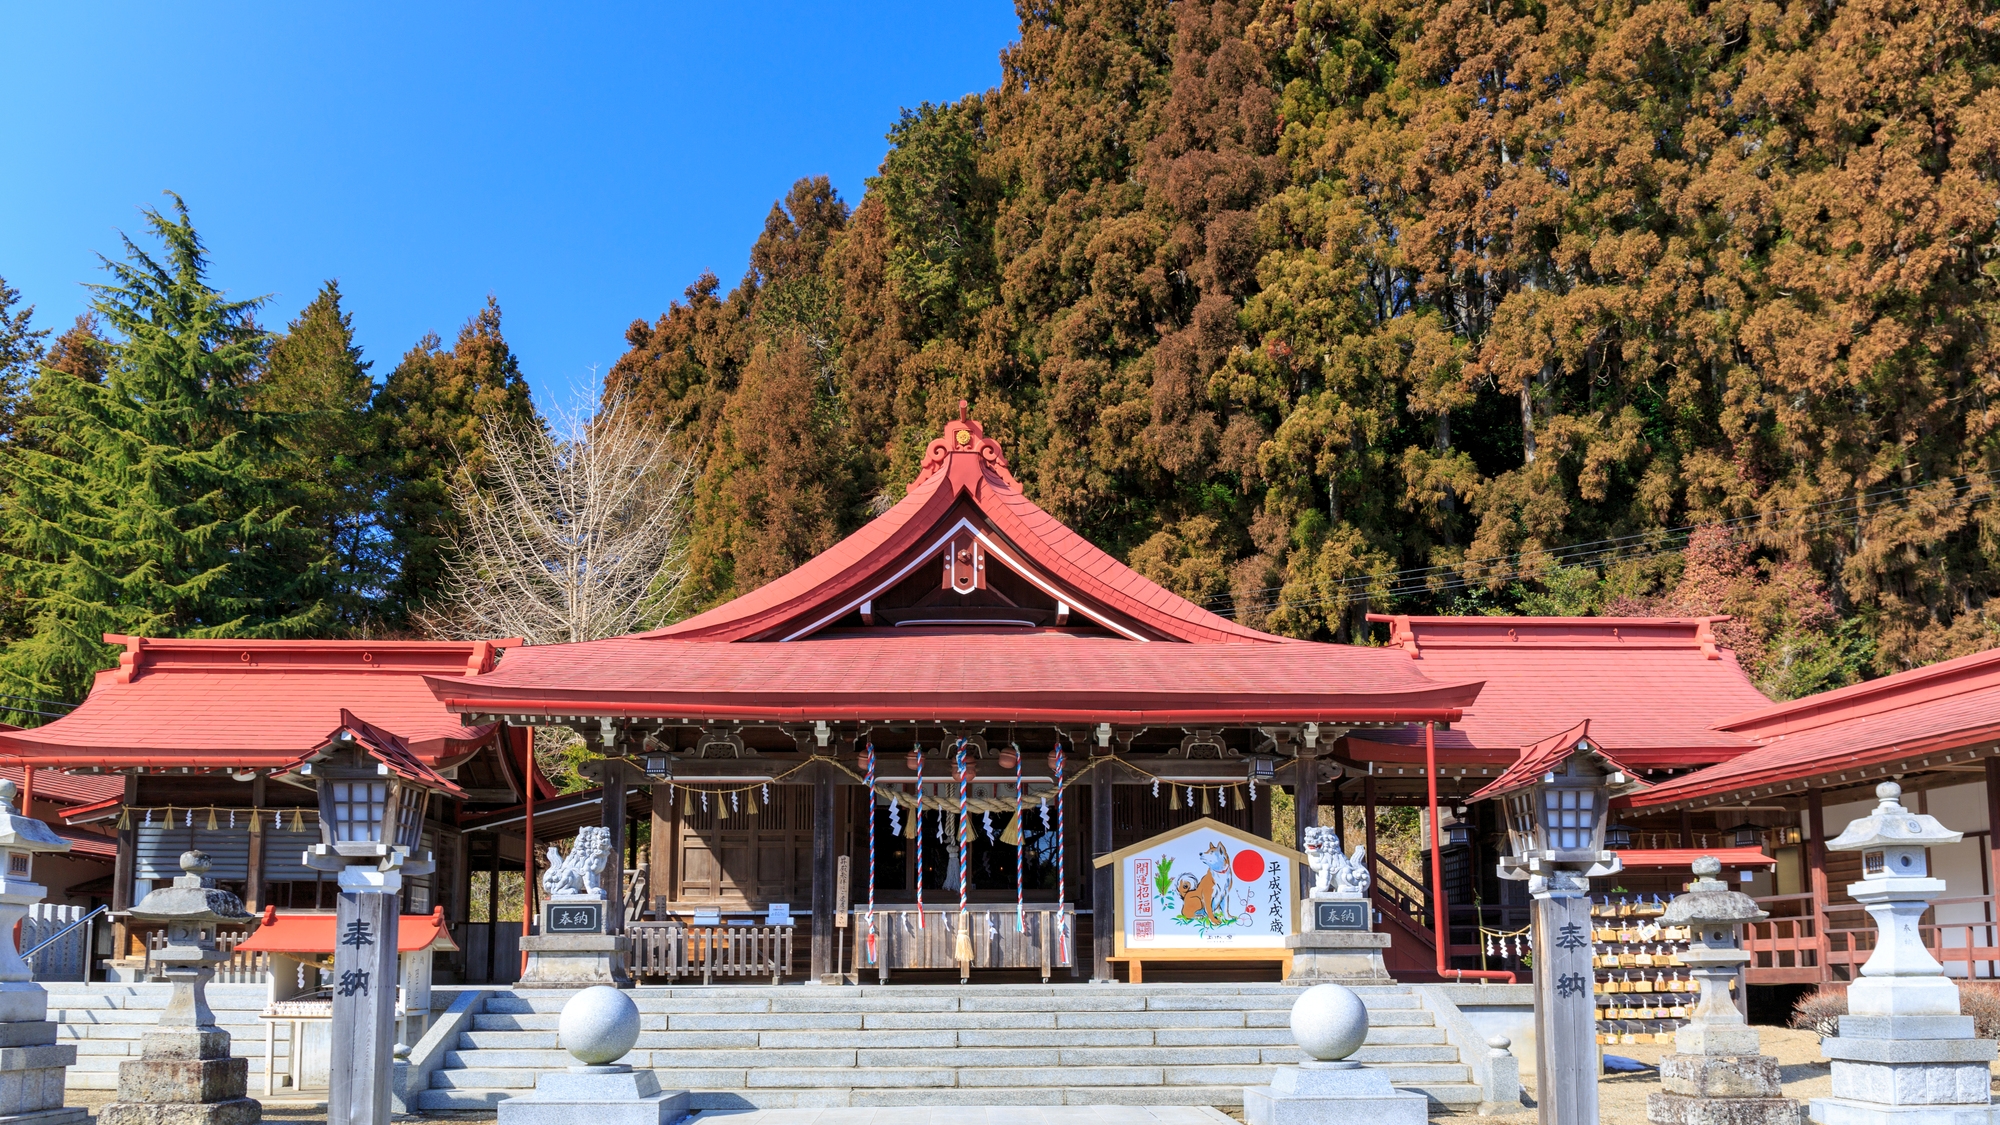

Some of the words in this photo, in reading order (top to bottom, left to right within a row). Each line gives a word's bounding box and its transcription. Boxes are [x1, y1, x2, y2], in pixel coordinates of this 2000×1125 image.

[558, 911, 588, 926] 奉納
[1136, 862, 1150, 914] 開運招福
[1268, 861, 1284, 935] 平成戊戌歳
[1327, 908, 1355, 923] 奉納
[337, 918, 375, 997] 奉納
[1555, 921, 1588, 999] 奉納
